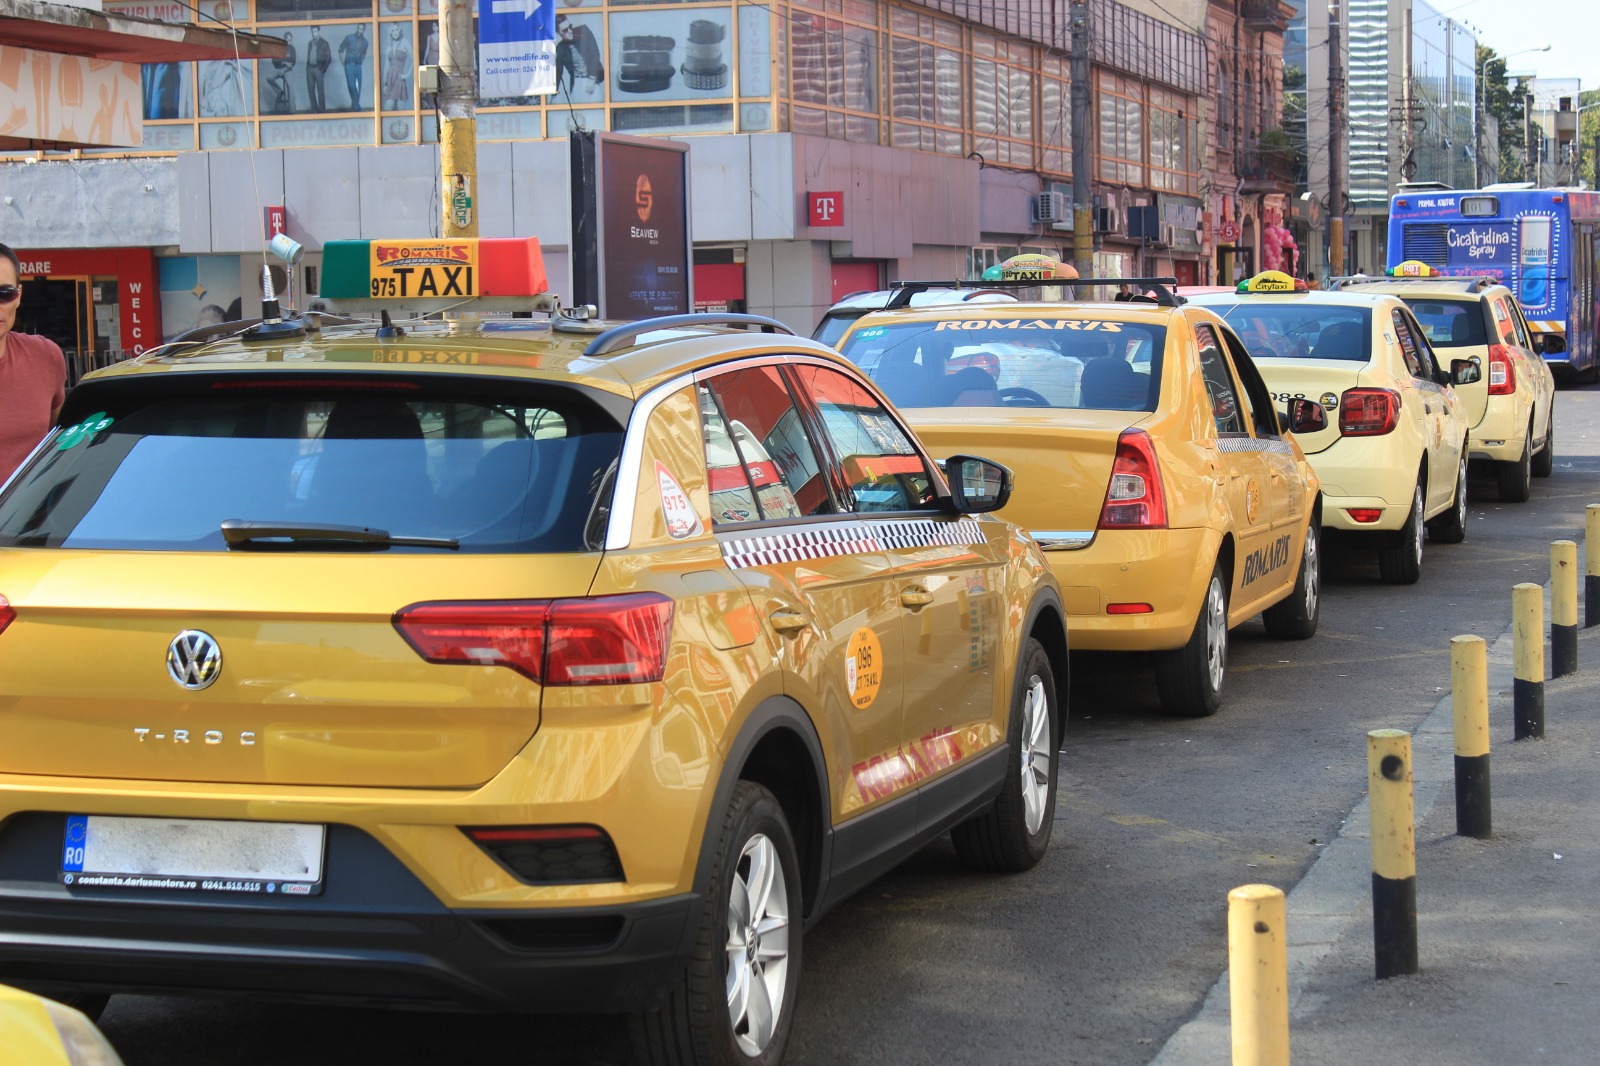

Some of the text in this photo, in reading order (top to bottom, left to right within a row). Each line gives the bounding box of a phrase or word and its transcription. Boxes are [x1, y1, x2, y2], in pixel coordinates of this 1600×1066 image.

[154, 5, 184, 20] MICI
[486, 53, 549, 63] www.medlife.ro
[272, 123, 369, 142] PANTALONI
[630, 226, 659, 239] SEAVIEW
[1225, 226, 1234, 237] 5
[1446, 227, 1510, 248] Cicatridina
[1468, 244, 1496, 259] Spray
[371, 267, 473, 297] 975 TAXI
[1012, 271, 1042, 280] TAXI
[1255, 283, 1287, 291] CityTaxi
[65, 419, 109, 436] 975
[664, 494, 686, 510] 975
[857, 645, 872, 670] 096
[134, 728, 255, 745] T-ROC
[65, 846, 83, 865] RO
[78, 876, 261, 892] constanta.dariusmotors.ro 0241.515.515
